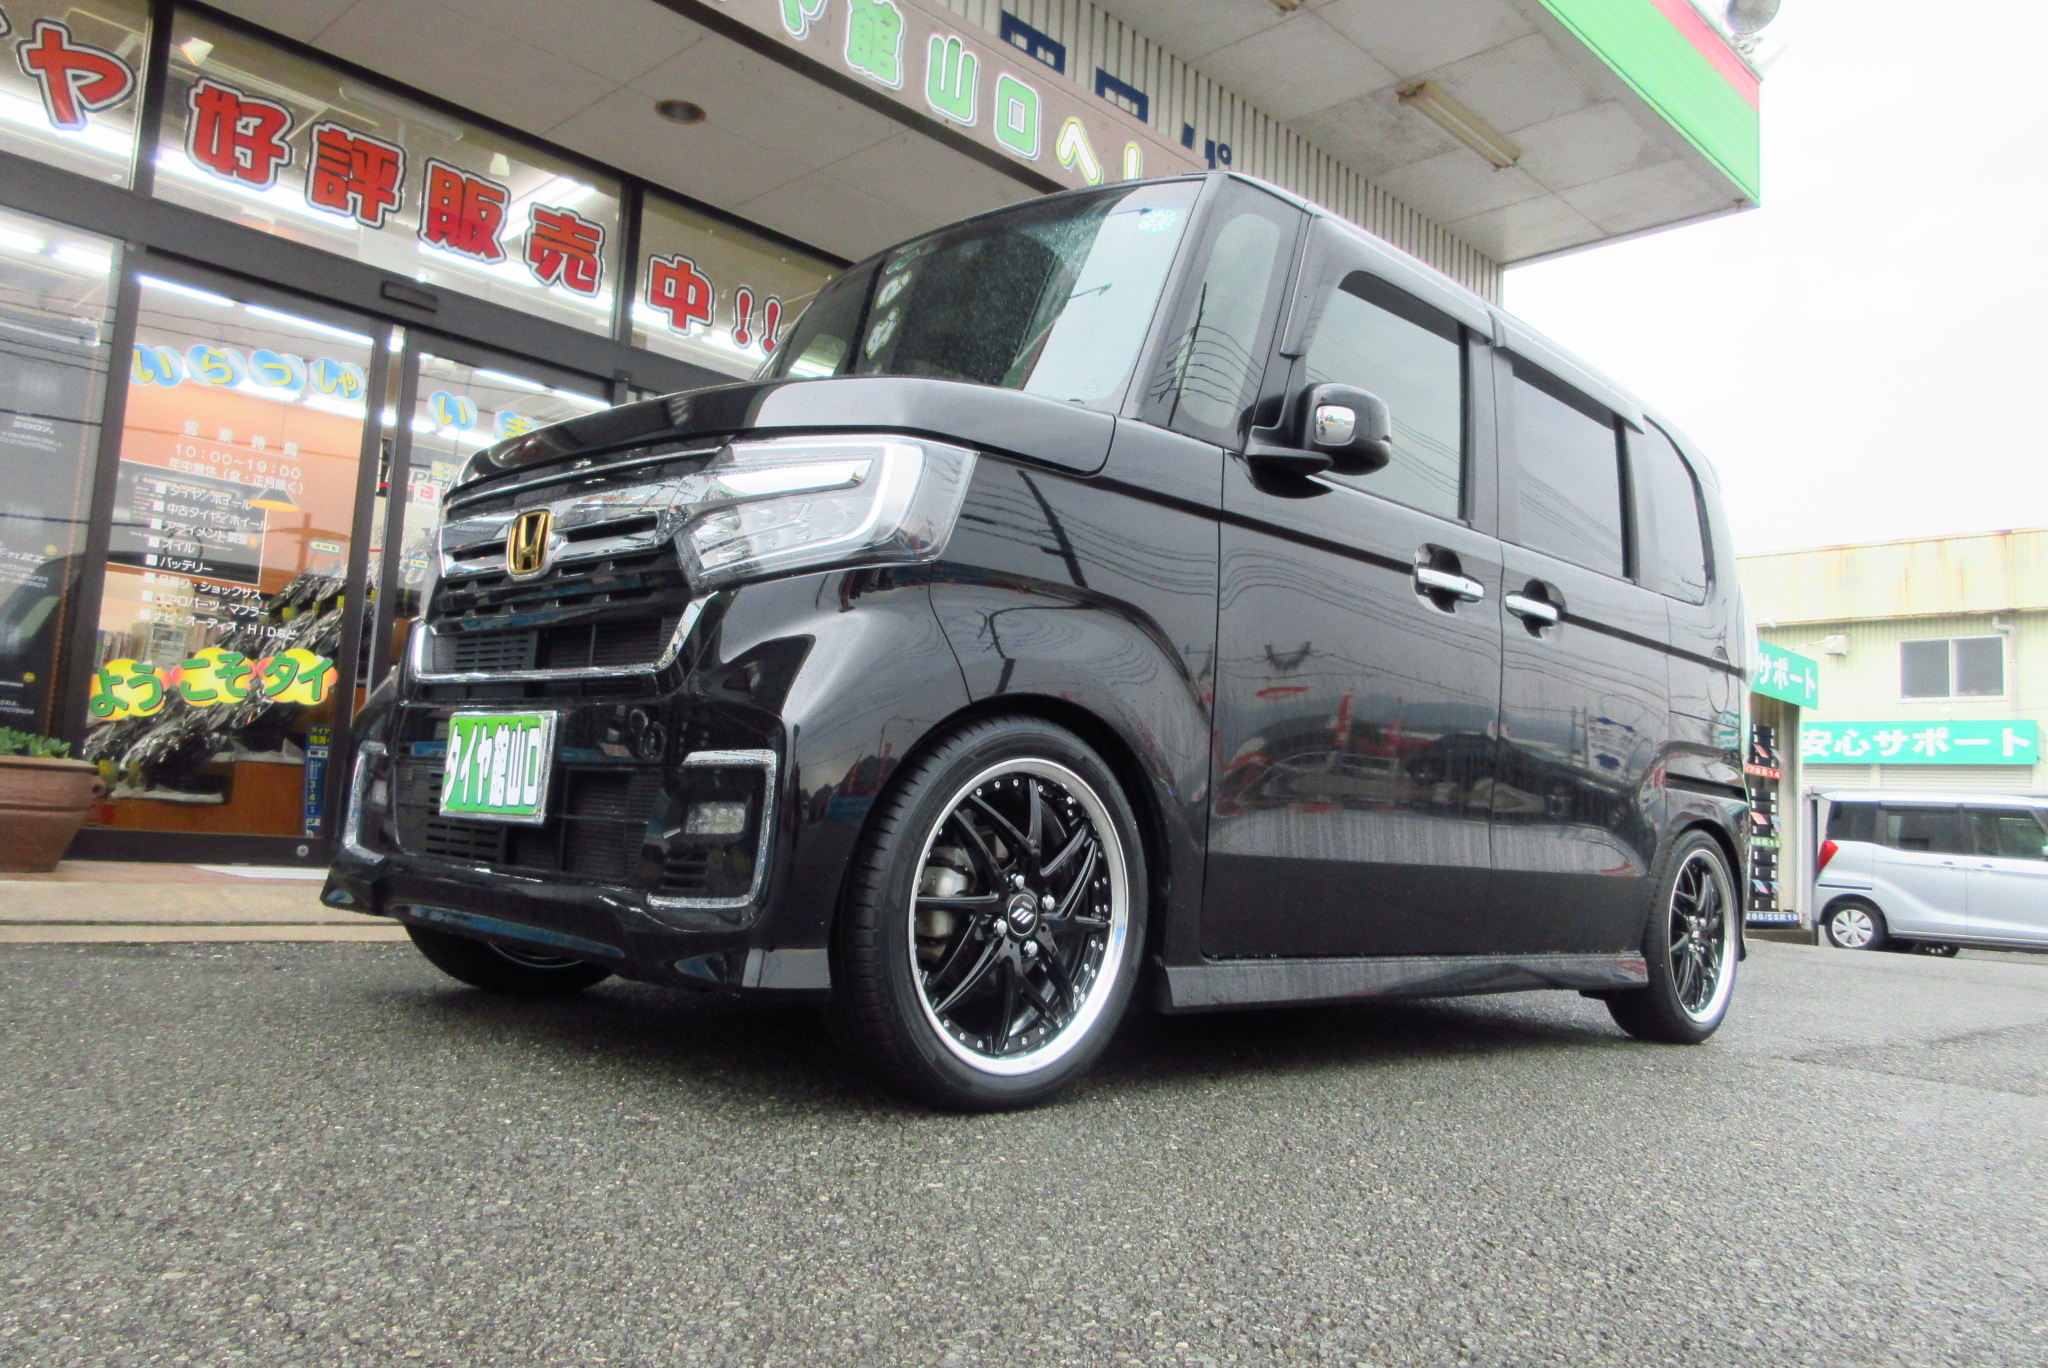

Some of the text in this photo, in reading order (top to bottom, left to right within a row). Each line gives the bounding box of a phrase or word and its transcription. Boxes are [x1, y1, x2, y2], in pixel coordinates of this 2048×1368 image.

[779, 0, 1143, 187] 館山口へ
[133, 348, 359, 398] いらっしゃ
[160, 556, 213, 573] バッテリー
[162, 540, 196, 554] オイル
[90, 652, 334, 718] ようこそタイ
[443, 721, 540, 807] タイヤ館山口
[1801, 727, 2031, 757] 安心サポート
